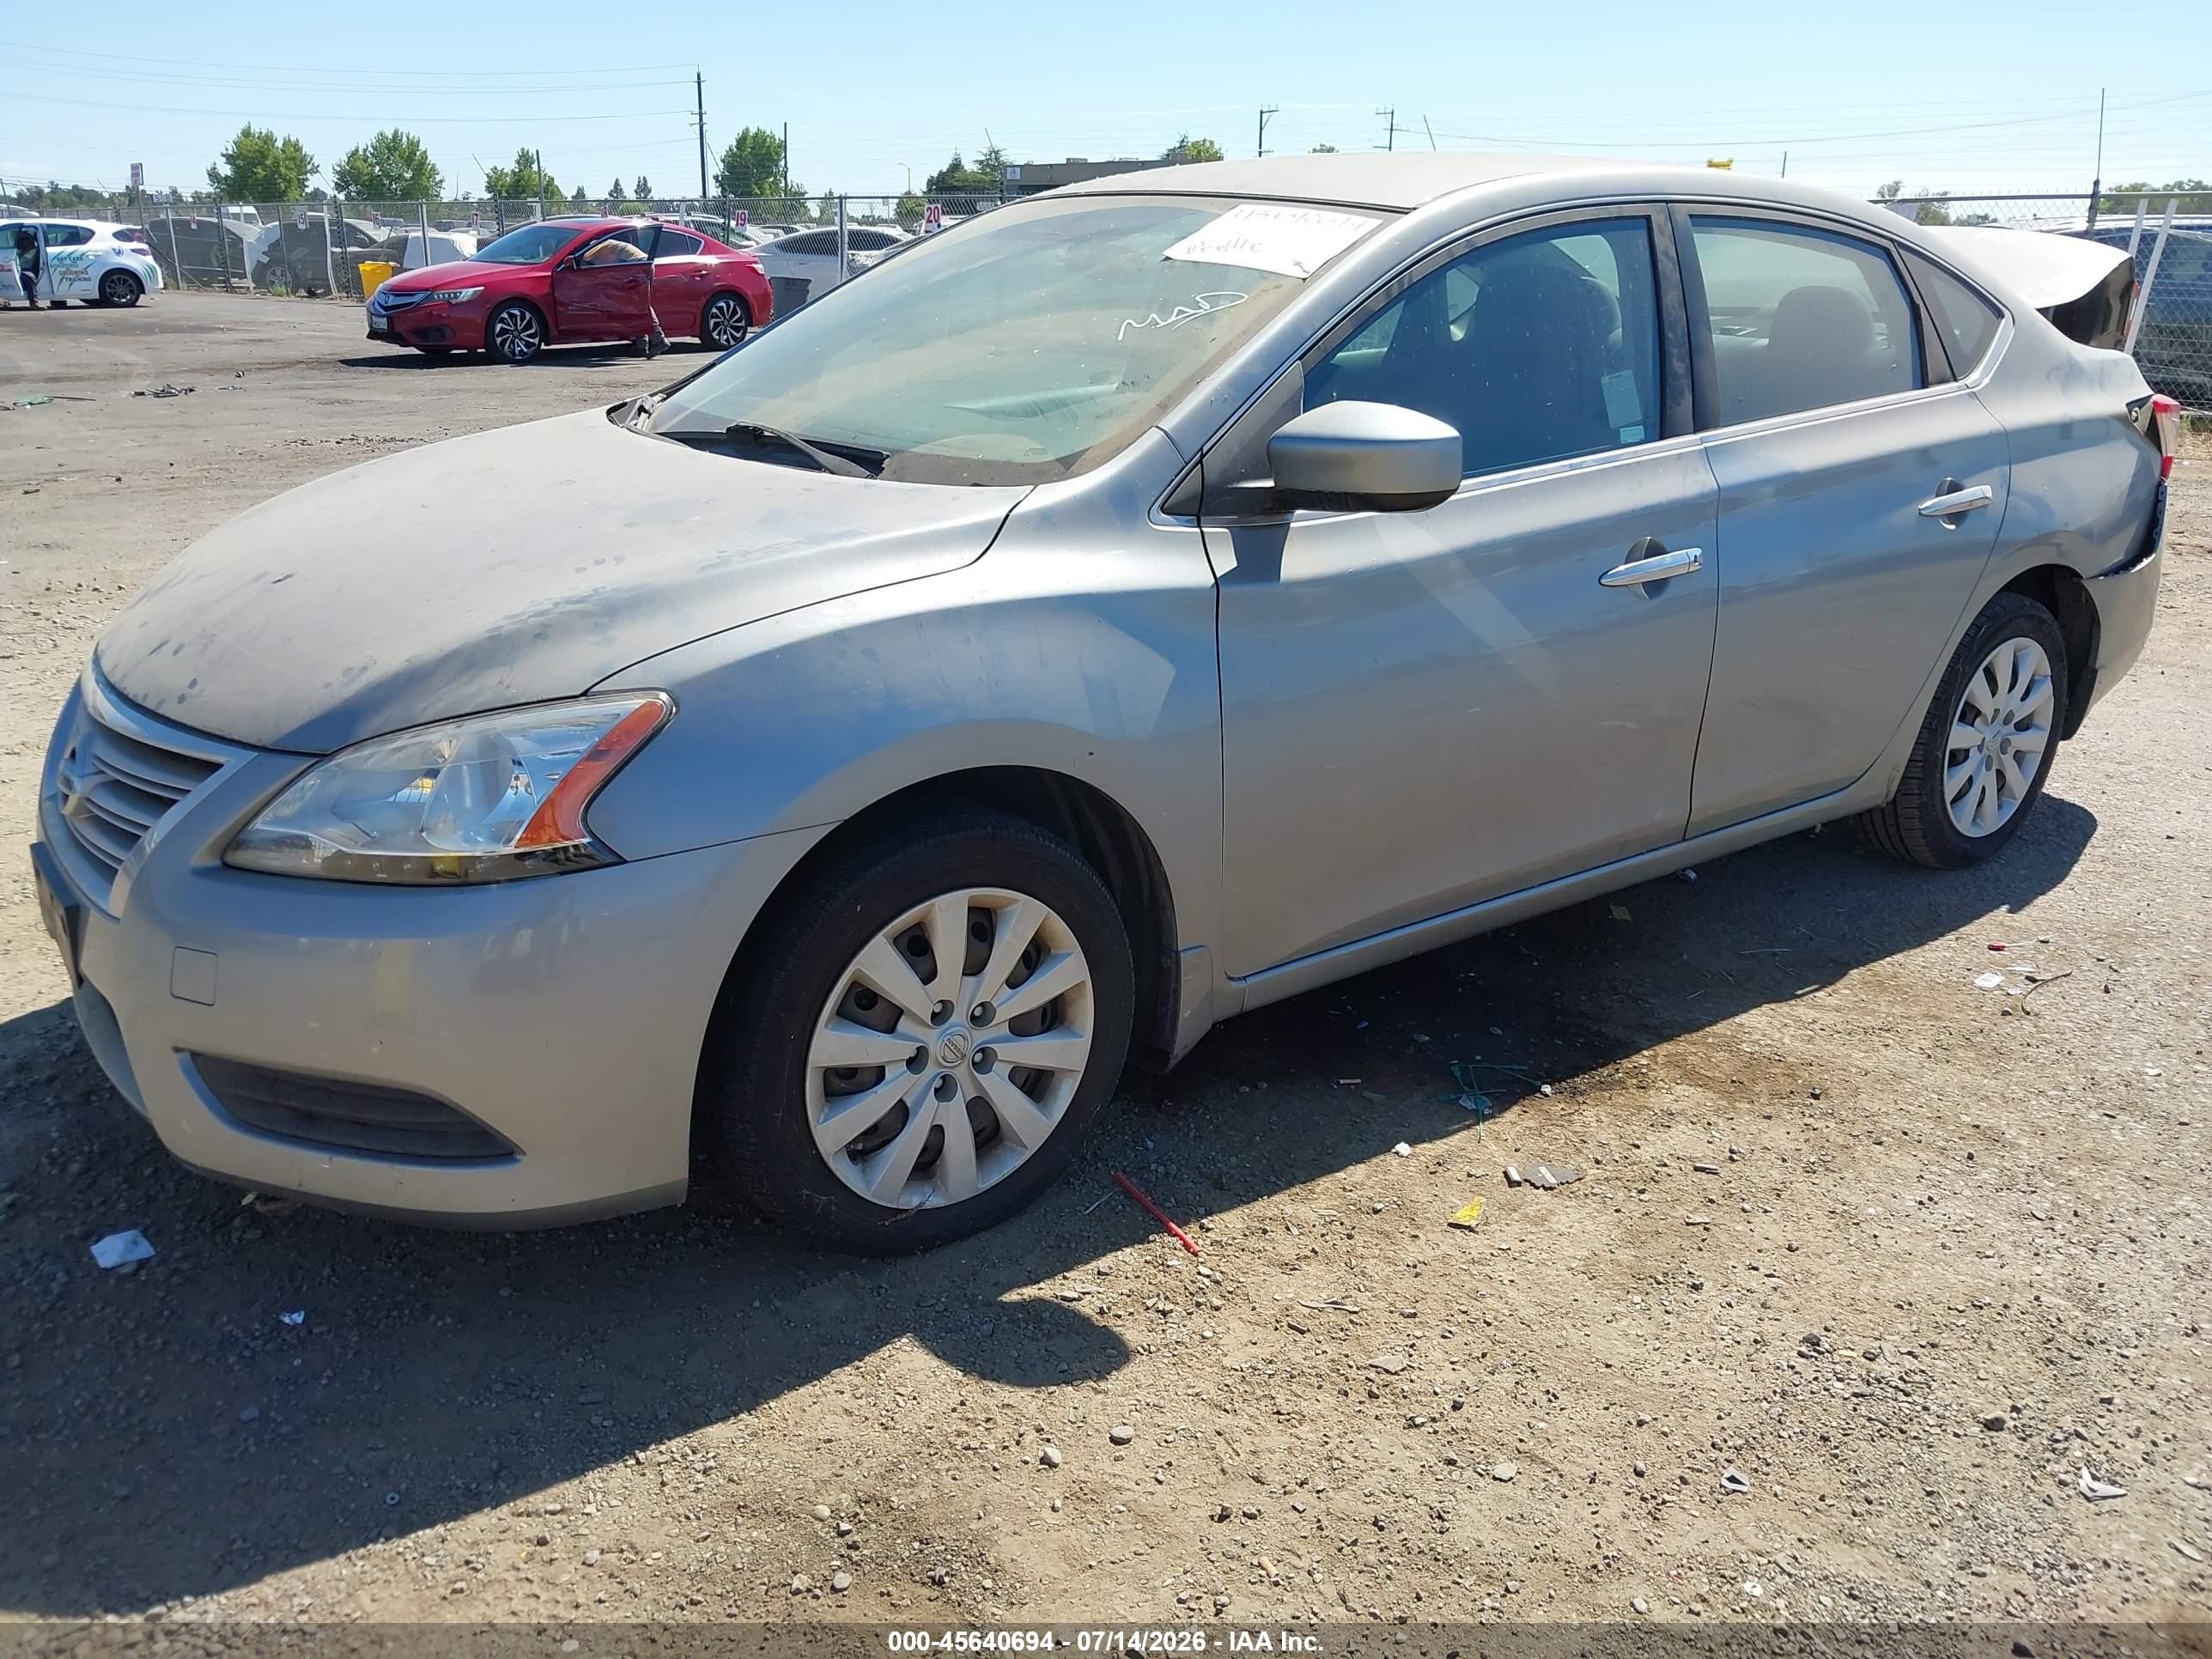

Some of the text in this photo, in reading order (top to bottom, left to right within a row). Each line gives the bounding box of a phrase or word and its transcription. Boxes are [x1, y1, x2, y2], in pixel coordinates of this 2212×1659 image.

[298, 213, 305, 225] 15
[372, 213, 380, 226] 16
[472, 213, 479, 226] 17
[735, 211, 747, 228] 19
[927, 206, 940, 224] 20
